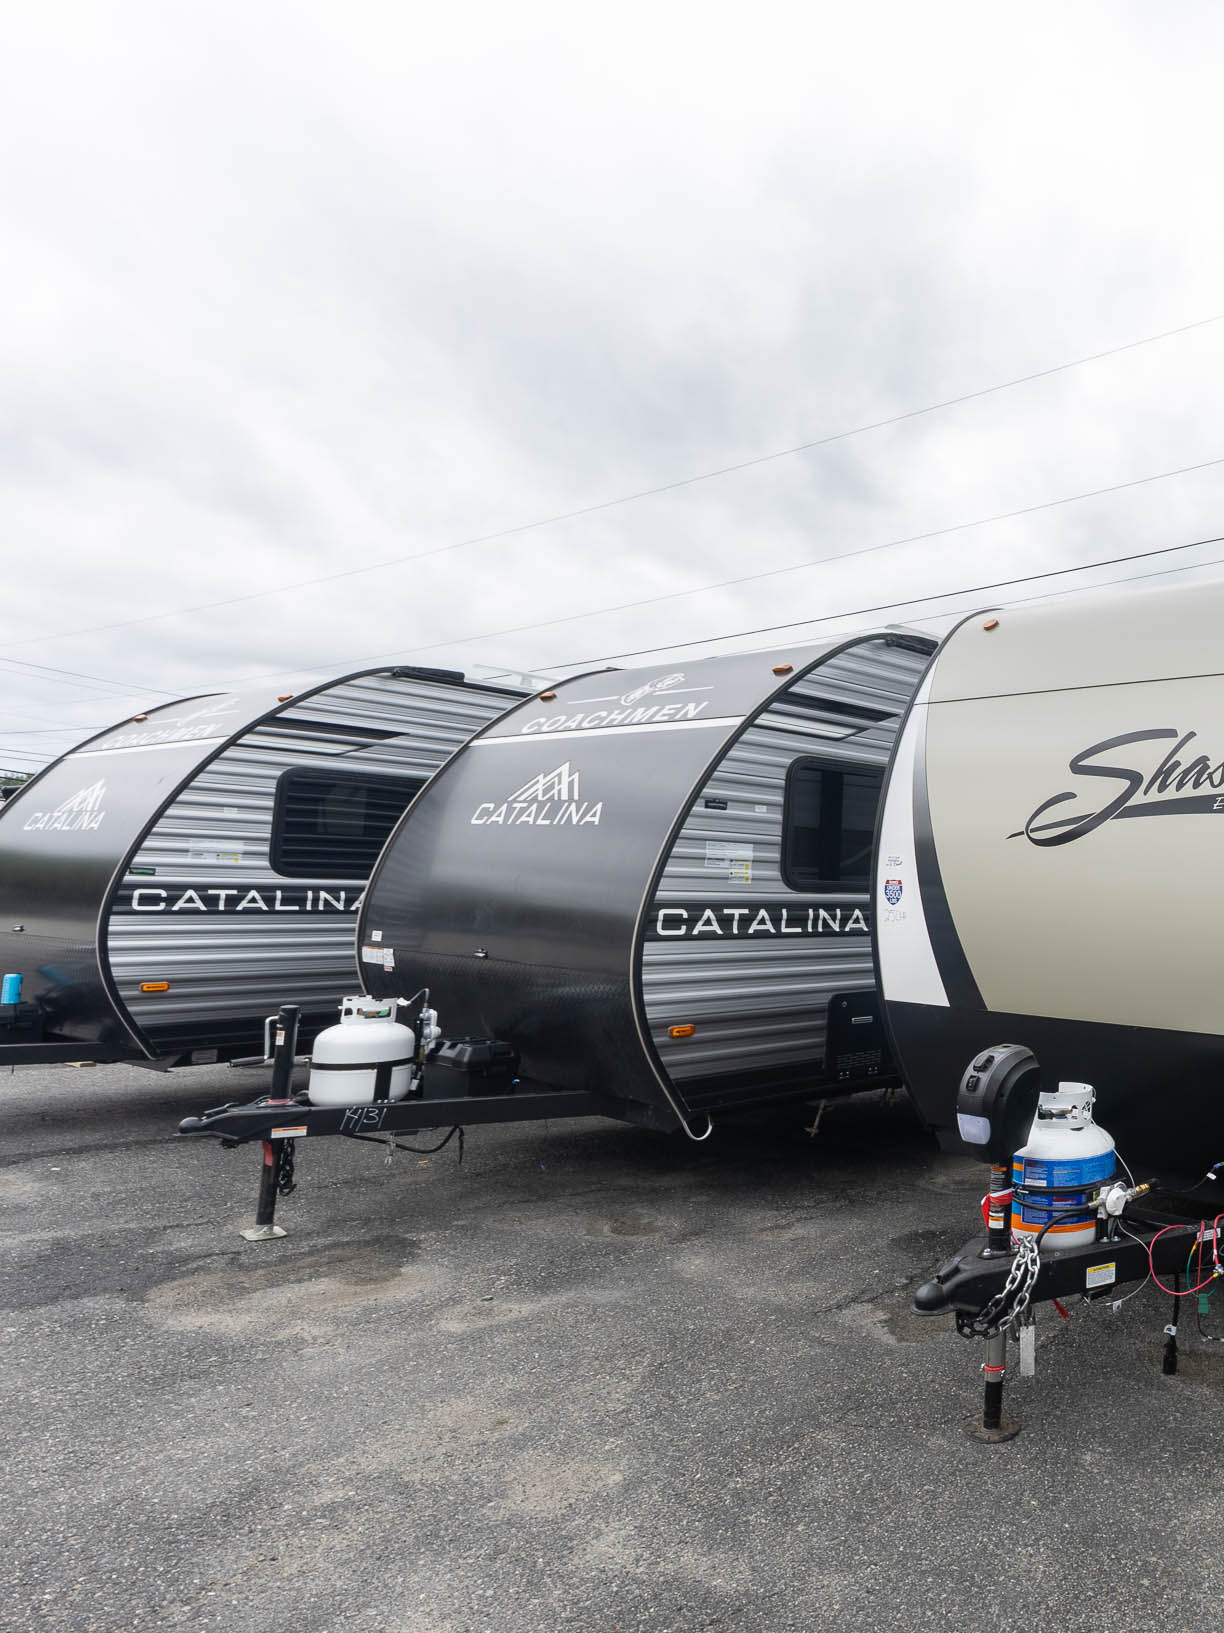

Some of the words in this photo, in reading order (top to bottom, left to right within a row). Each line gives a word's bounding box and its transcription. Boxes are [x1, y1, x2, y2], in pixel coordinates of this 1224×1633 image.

[522, 701, 709, 733] COACHMEN
[23, 811, 106, 831] CATALINA
[470, 802, 604, 825] CATALINA
[886, 890, 902, 898] 3500
[656, 908, 869, 936] CATALINA
